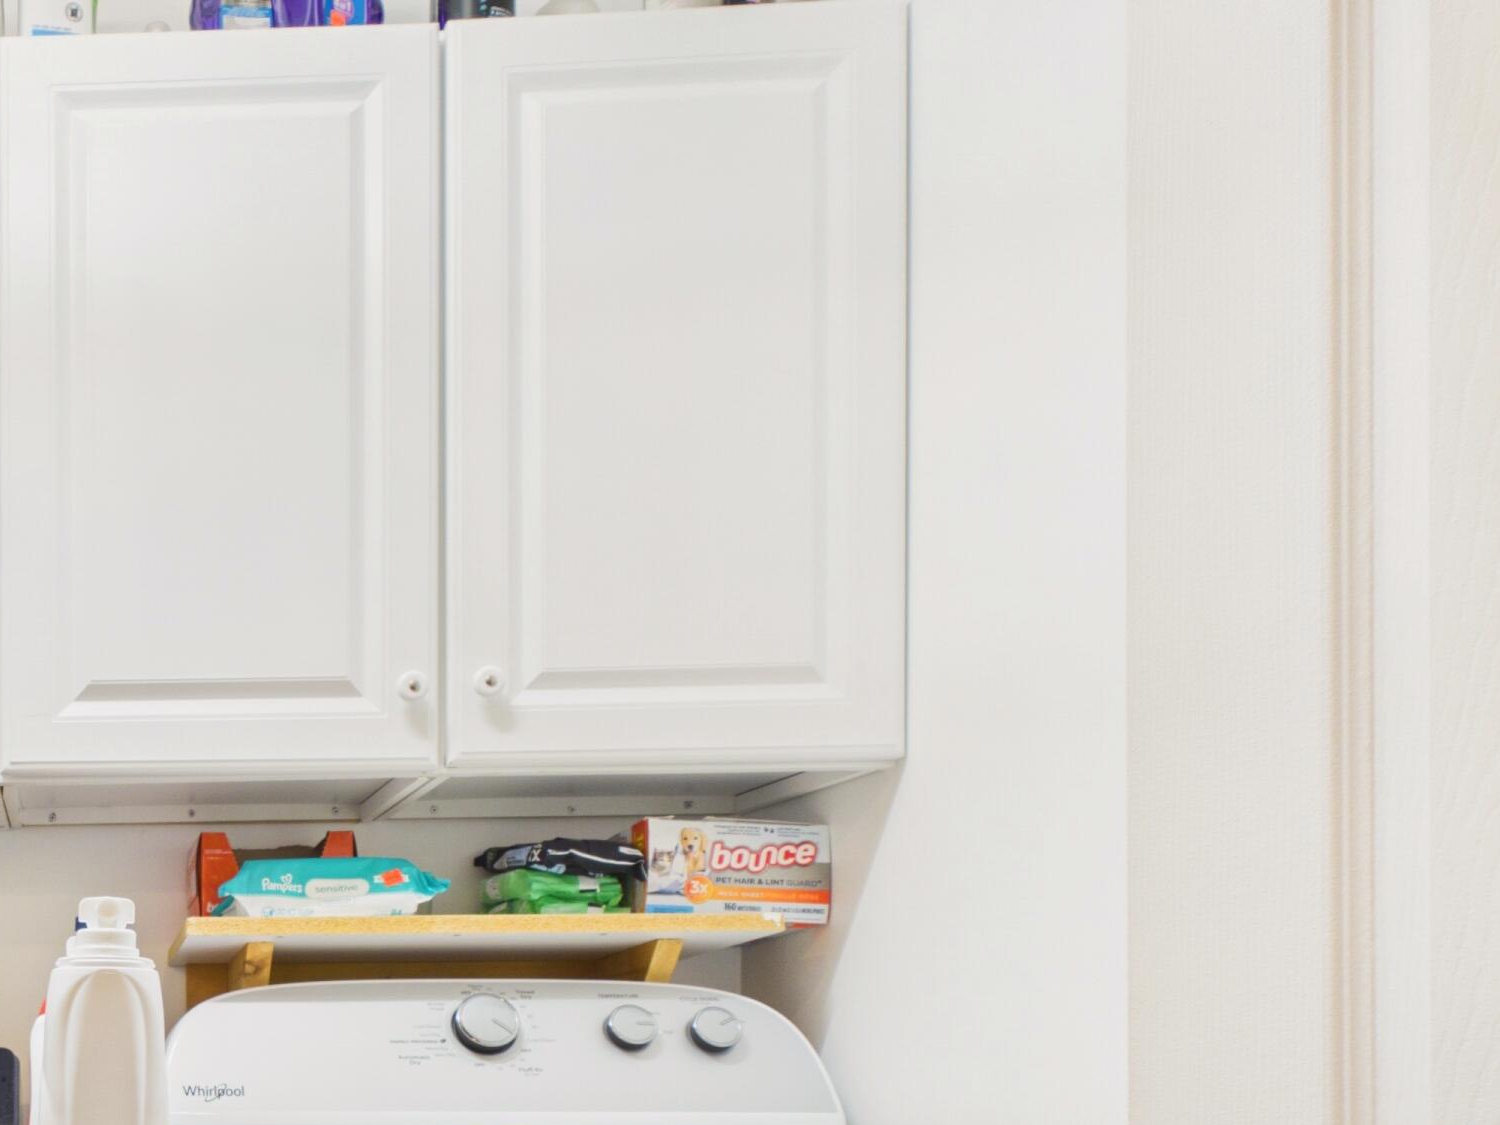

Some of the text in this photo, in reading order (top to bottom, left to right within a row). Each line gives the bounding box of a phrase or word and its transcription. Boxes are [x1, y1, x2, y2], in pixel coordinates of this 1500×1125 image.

[711, 841, 817, 873] bounce
[261, 875, 302, 893] Pampers
[690, 880, 709, 894] 3x
[715, 876, 732, 884] PET
[734, 877, 756, 885] HAIR
[315, 884, 358, 893] sensitive
[182, 1084, 245, 1100] Whirlpool
